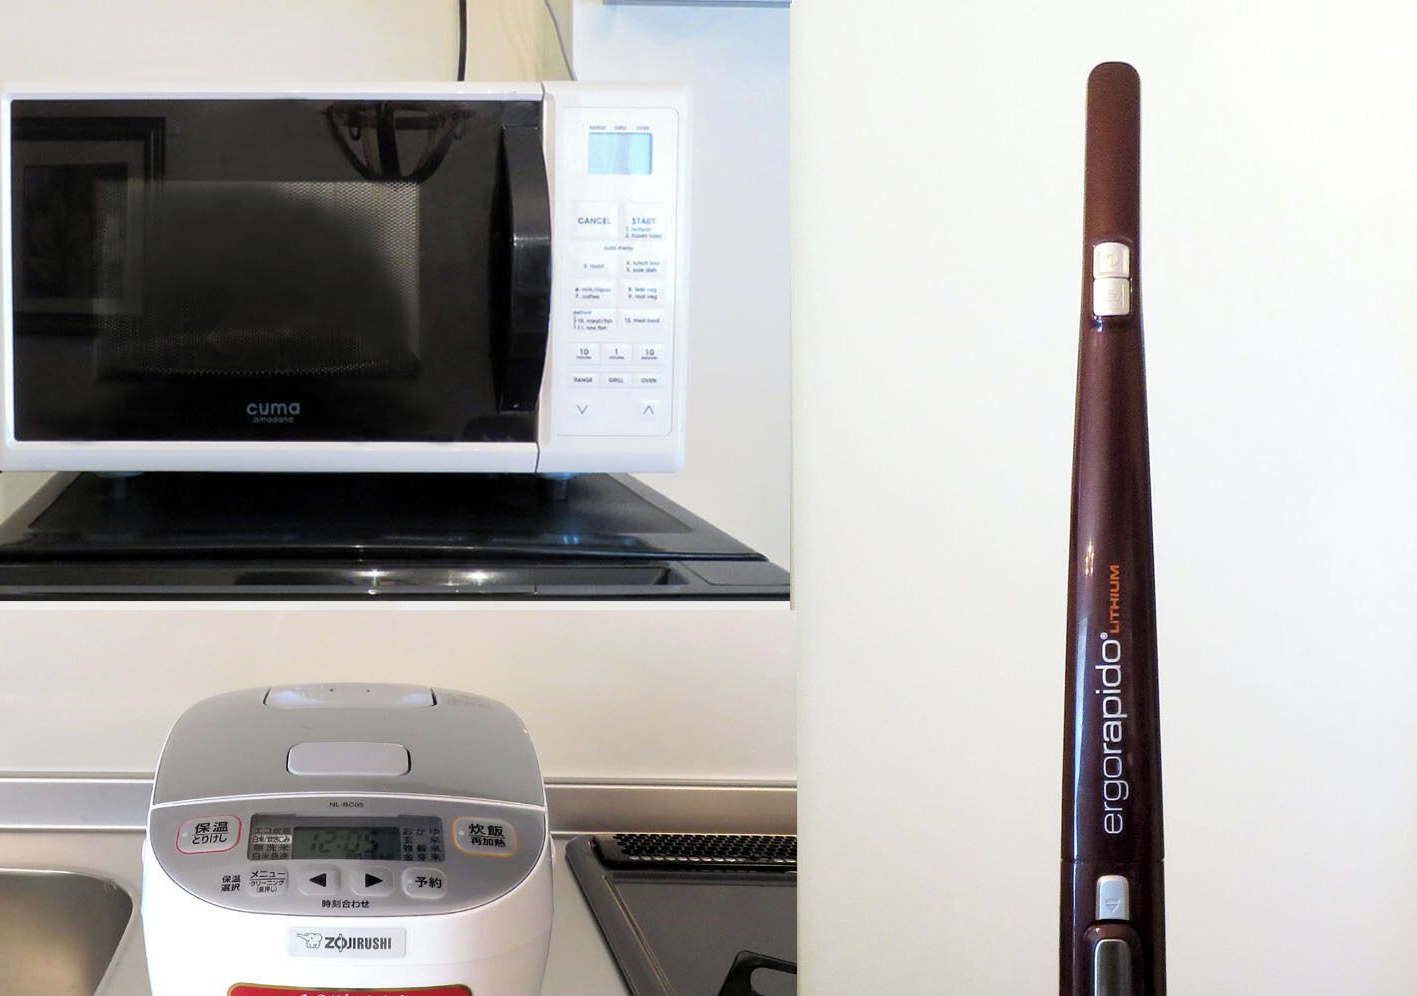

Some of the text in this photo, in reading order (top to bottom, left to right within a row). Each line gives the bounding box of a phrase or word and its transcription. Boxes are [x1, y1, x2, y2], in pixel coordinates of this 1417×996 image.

[577, 217, 611, 225] CANCEL
[245, 401, 301, 416] cuma
[1109, 564, 1121, 634] LITHIUM
[194, 821, 229, 834] 保温
[468, 823, 504, 837] 炊飯
[192, 834, 228, 845] とりけし
[250, 870, 286, 879] メニュー
[414, 876, 442, 888] 予約
[321, 899, 370, 909] 時刻合わせ
[325, 933, 392, 953] ZOJIRUSHI
